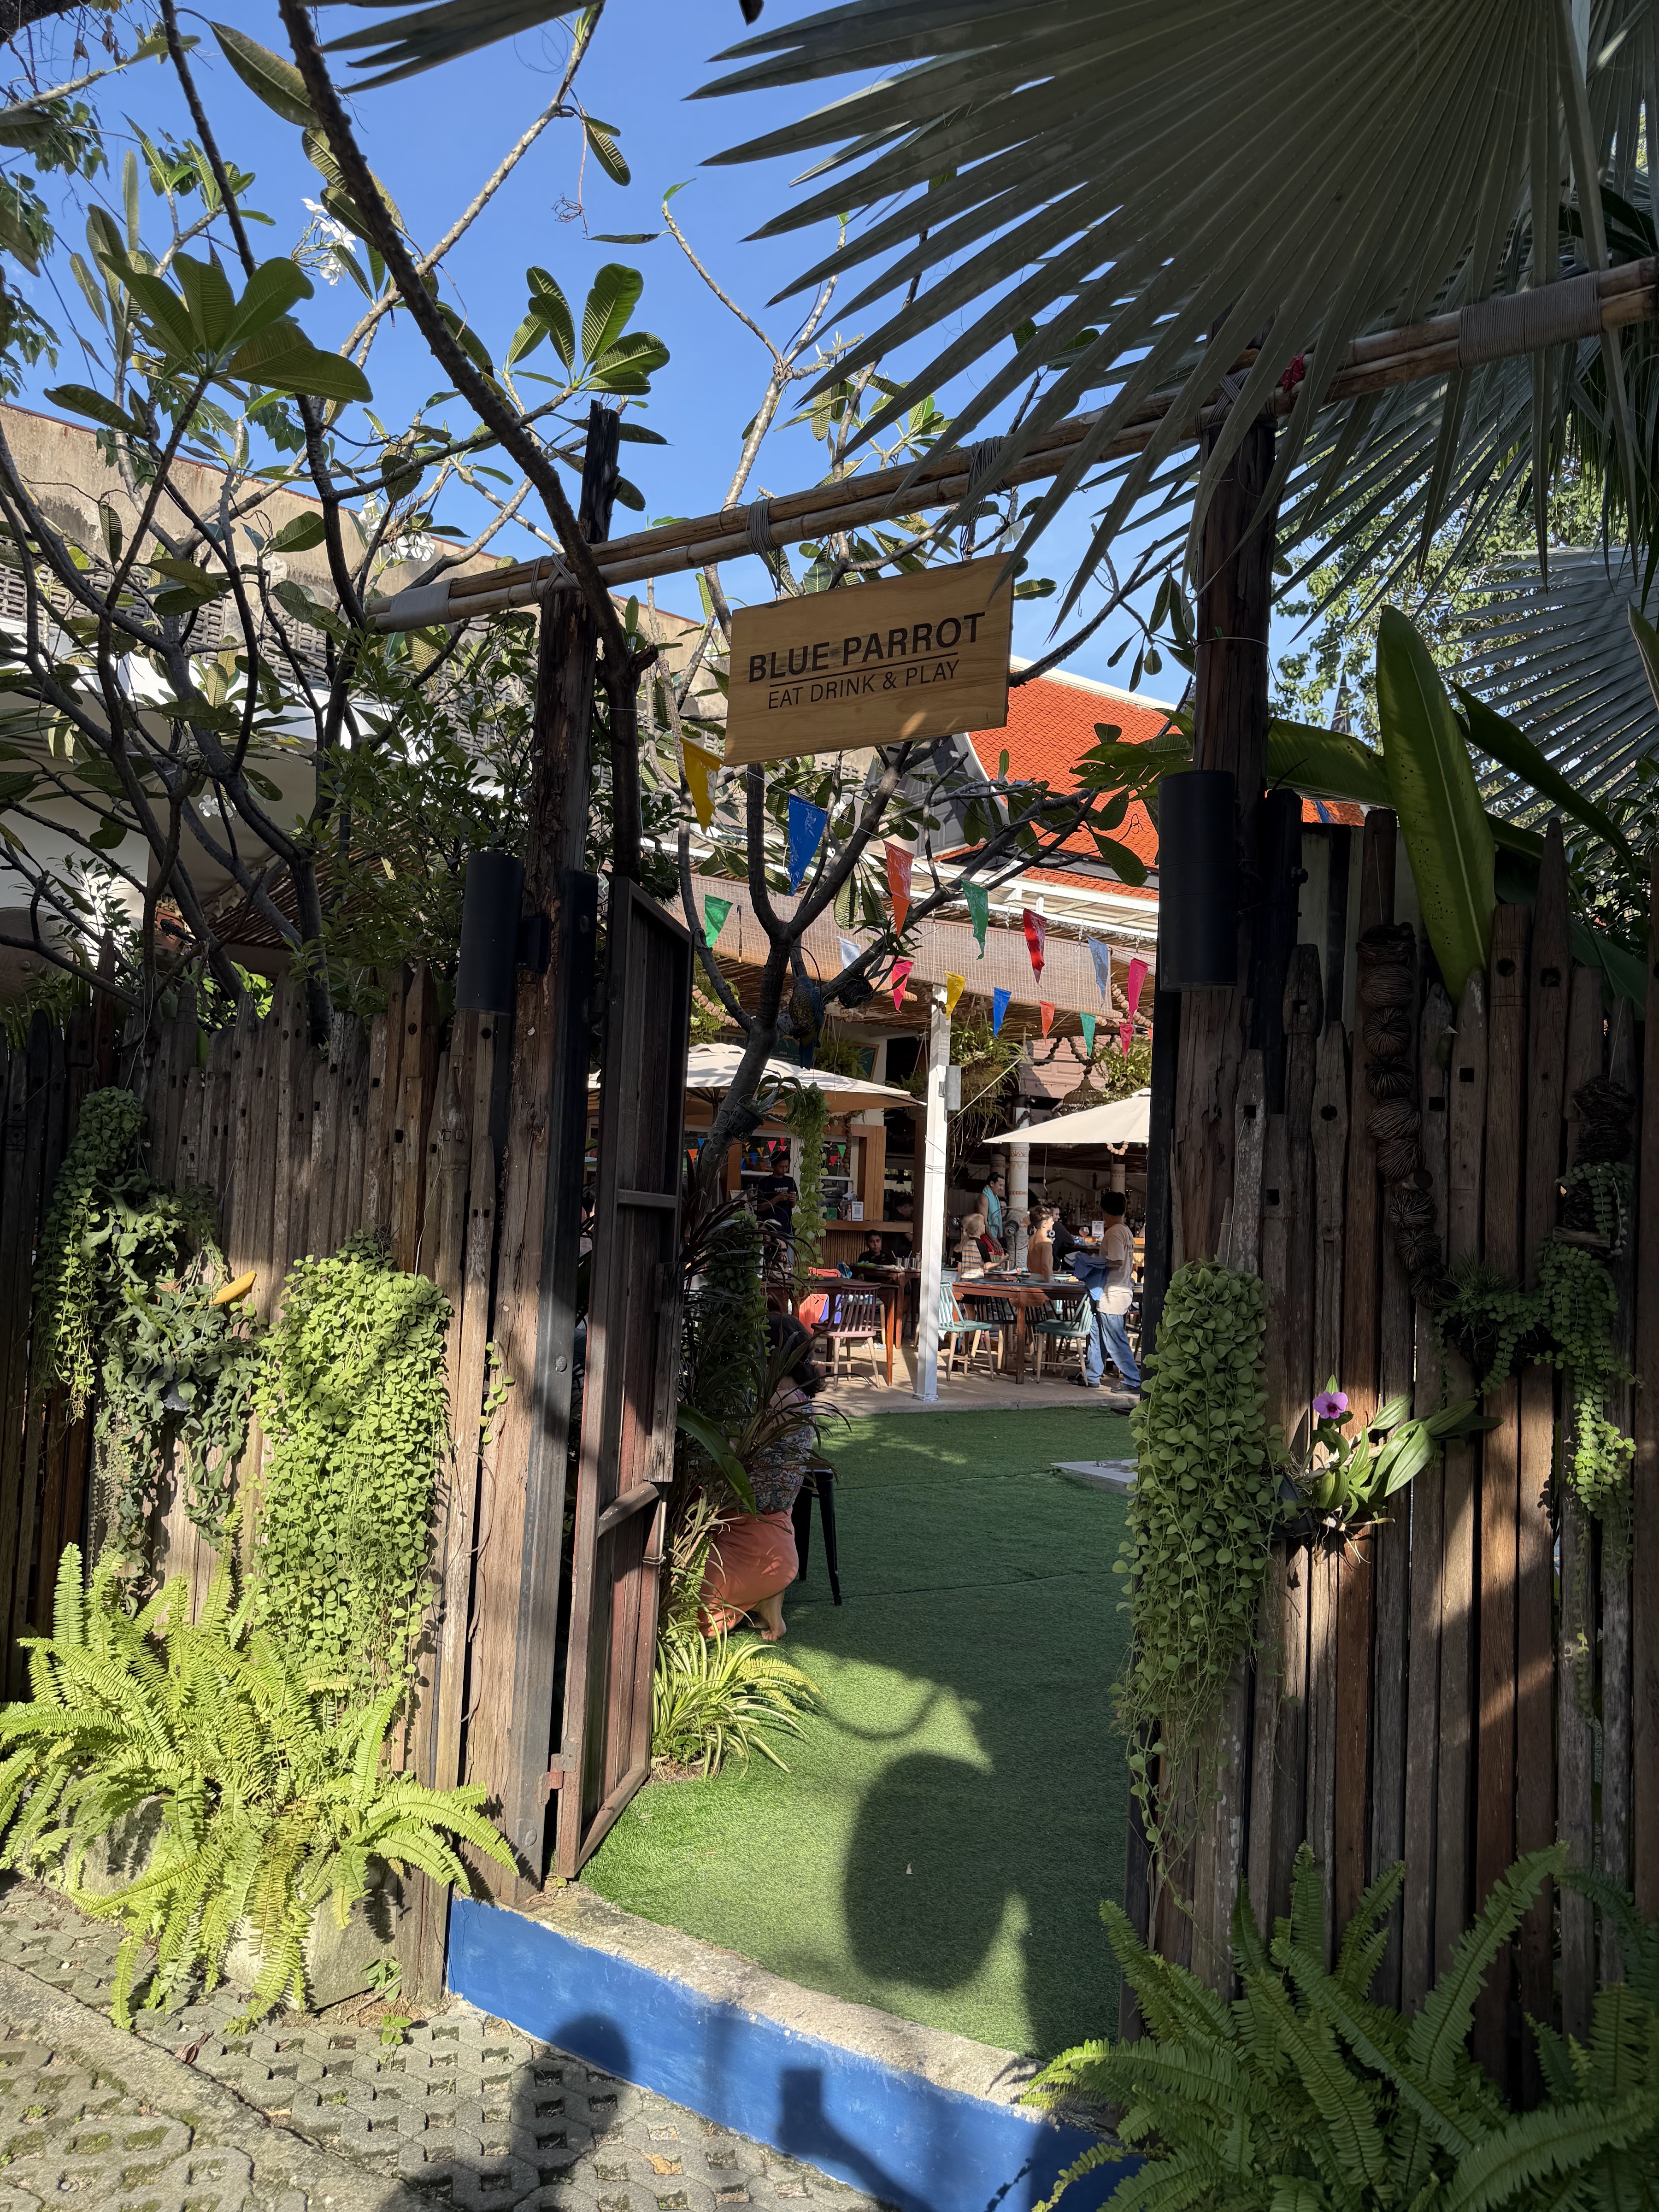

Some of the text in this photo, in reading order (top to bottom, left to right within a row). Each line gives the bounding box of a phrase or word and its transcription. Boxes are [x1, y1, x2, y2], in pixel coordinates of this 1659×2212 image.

[749, 612, 985, 682] BLUE PARROT
[768, 659, 960, 710] EAT DRINK & PLAY
